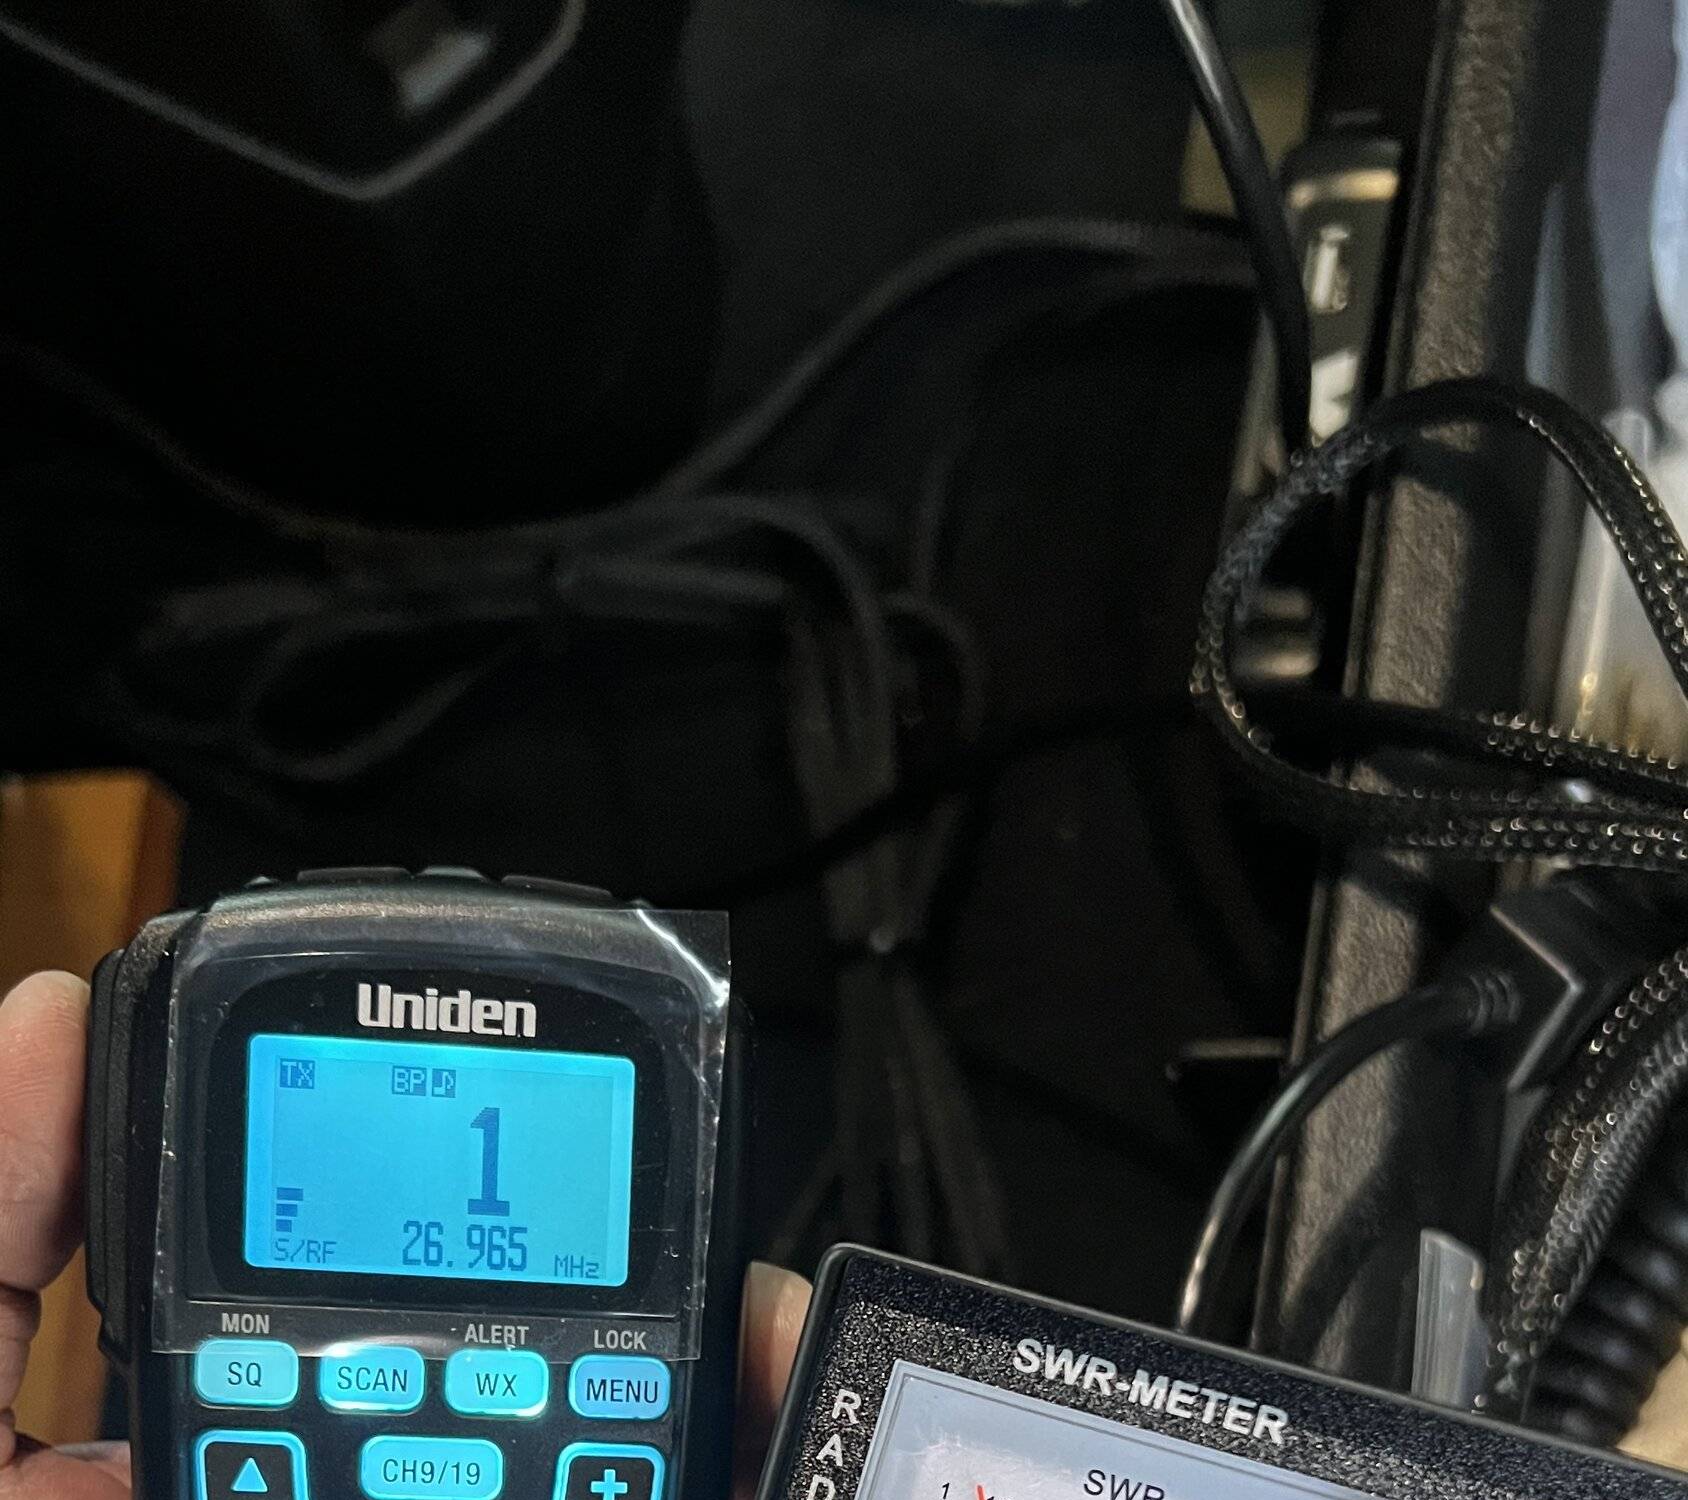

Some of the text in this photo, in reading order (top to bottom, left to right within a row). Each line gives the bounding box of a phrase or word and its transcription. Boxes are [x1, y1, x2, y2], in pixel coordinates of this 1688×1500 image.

[357, 983, 537, 1038] Uniden
[280, 1058, 426, 1095] TX BP
[467, 1107, 510, 1217] 1
[273, 1238, 336, 1264] S/RF
[402, 1220, 528, 1271] 26.965
[554, 1254, 600, 1280] MHz
[221, 1313, 270, 1334] MON
[464, 1324, 530, 1346] ALERT
[593, 1330, 647, 1350] LOCK
[227, 1361, 262, 1388] SQ
[336, 1366, 408, 1394] SCAN
[476, 1373, 518, 1397] WX
[586, 1378, 659, 1404] MENU
[1012, 1338, 1290, 1446] SWR-METER
[383, 1459, 481, 1486] CH9/19
[941, 1482, 951, 1500] 1
